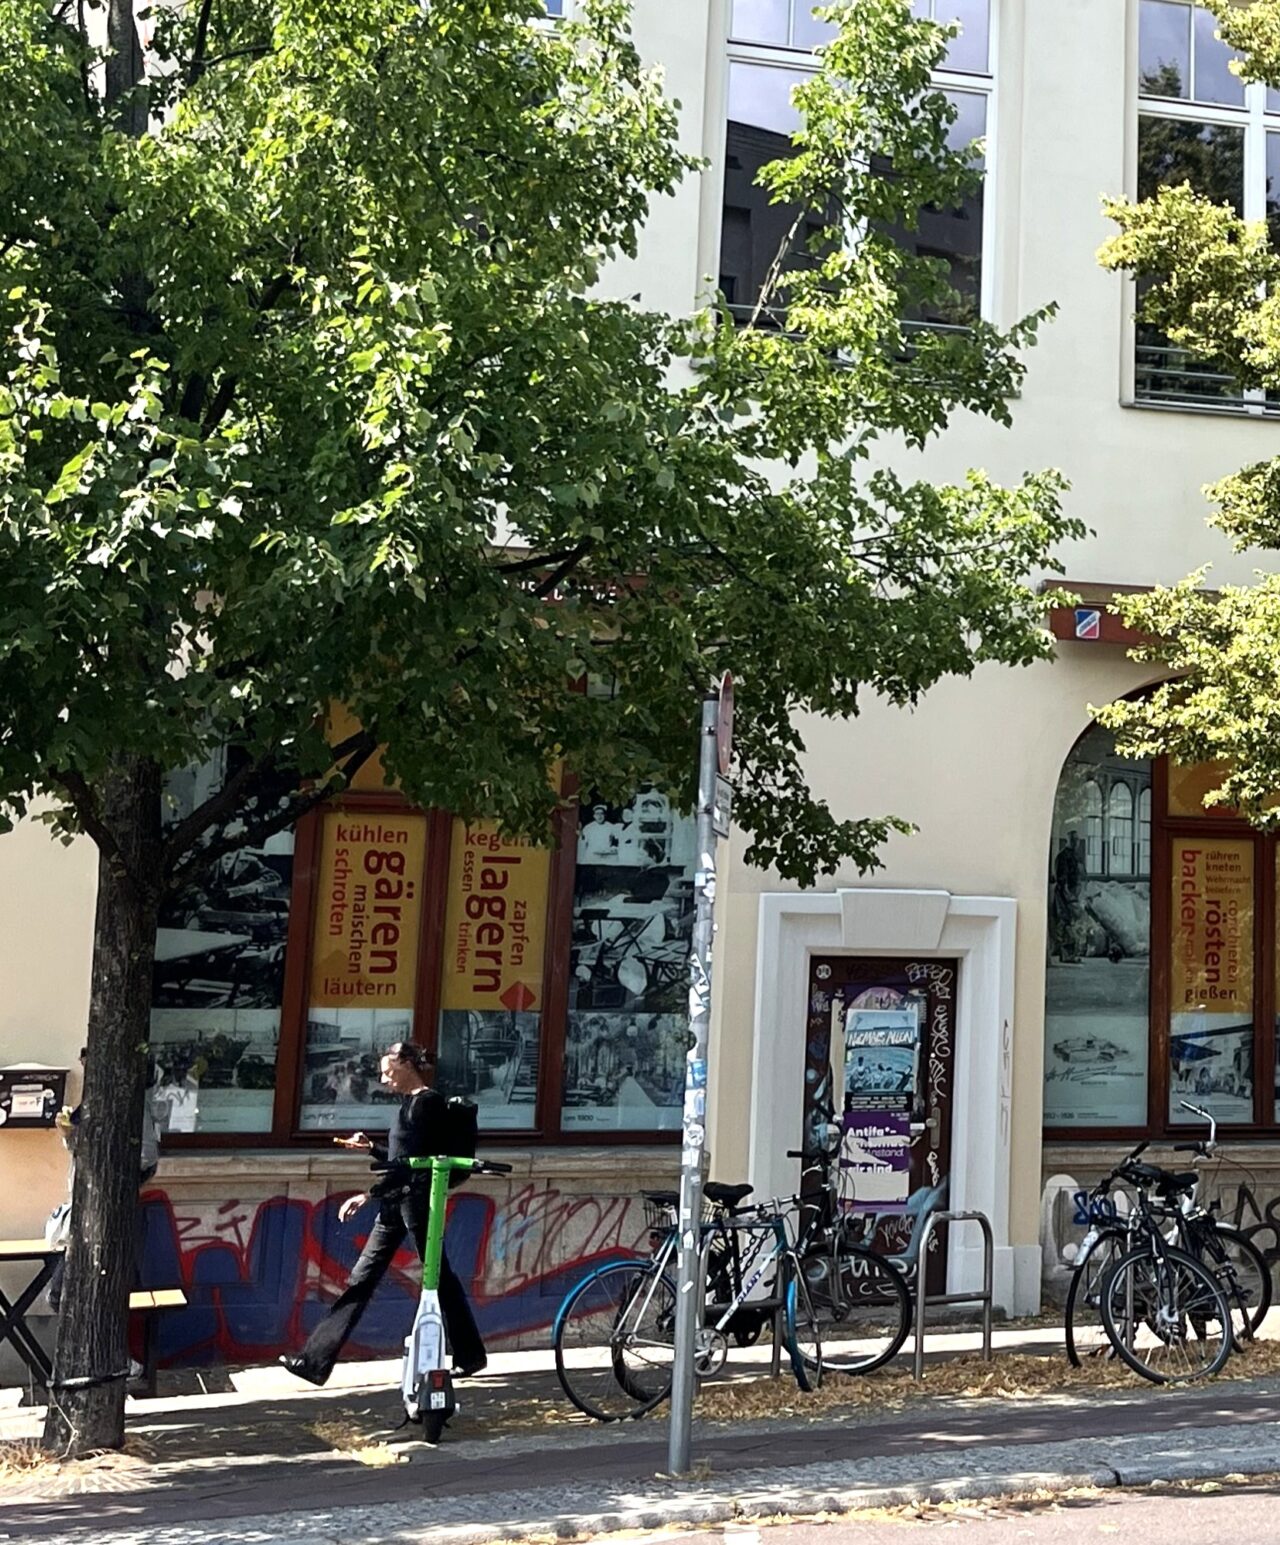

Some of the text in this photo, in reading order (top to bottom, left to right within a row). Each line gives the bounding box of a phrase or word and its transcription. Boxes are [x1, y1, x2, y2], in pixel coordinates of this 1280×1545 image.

[336, 824, 408, 844] kühlen
[1206, 851, 1240, 861] rühren
[329, 848, 353, 936] schroten
[462, 850, 475, 892] essen
[1206, 862, 1241, 872] kneten
[347, 884, 369, 974] maischen
[364, 849, 414, 974] gären
[465, 856, 521, 992] lagern
[508, 900, 529, 966] zapfen
[456, 921, 471, 974] trinken
[1205, 899, 1227, 983] rösten
[324, 978, 396, 996] läutern
[1185, 985, 1237, 1003] gießen
